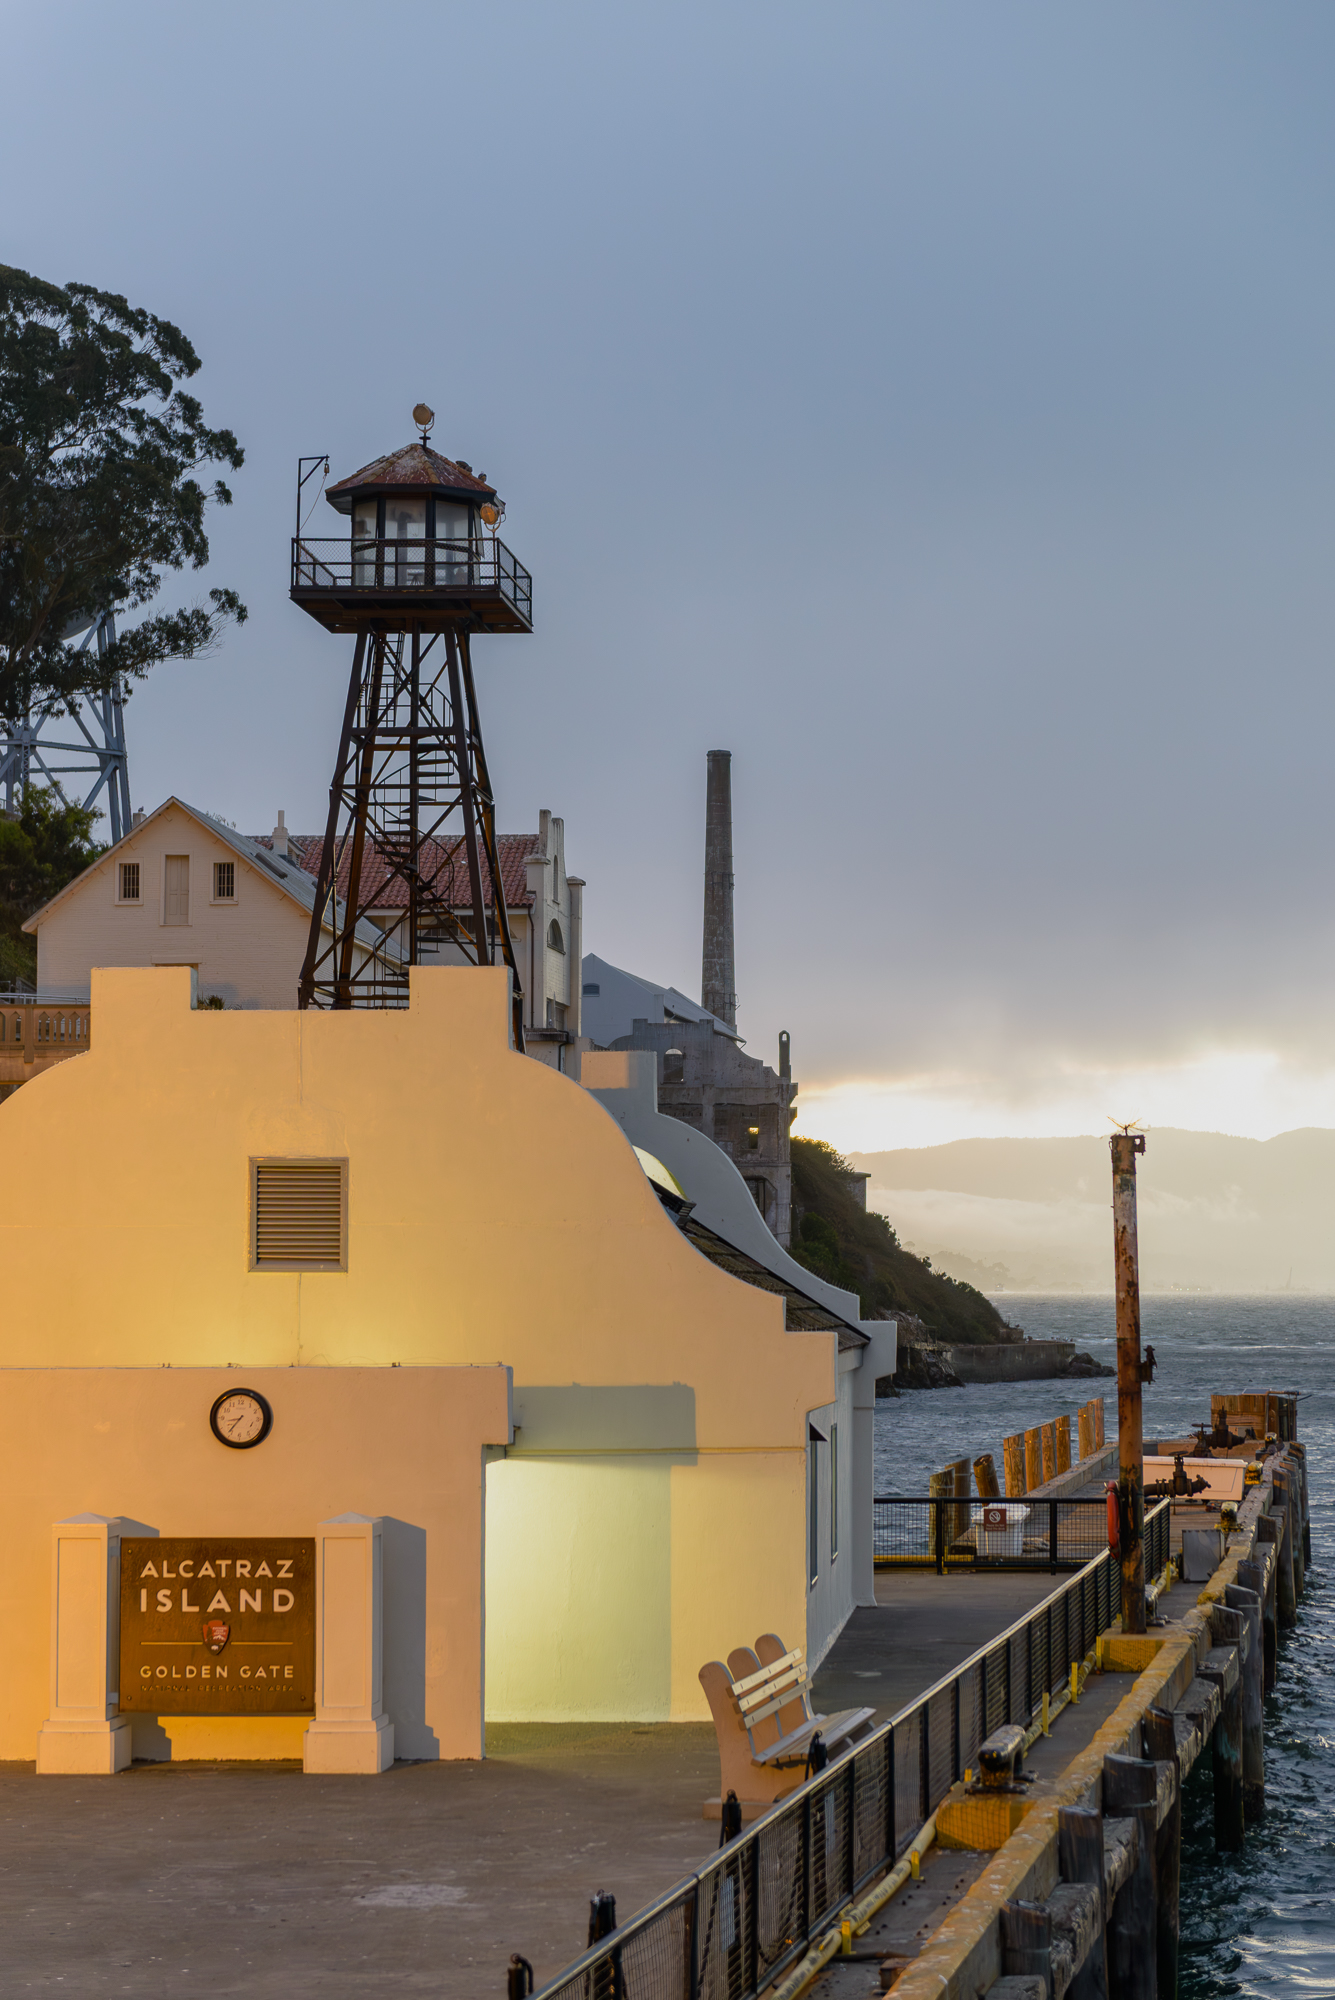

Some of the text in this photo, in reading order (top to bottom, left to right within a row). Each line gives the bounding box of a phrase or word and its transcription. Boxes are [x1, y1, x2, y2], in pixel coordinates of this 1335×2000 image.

[140, 1560, 294, 1578] ALCATRAZ
[140, 1588, 295, 1612] ISLAND
[140, 1665, 294, 1678] GOLDEN GATE
